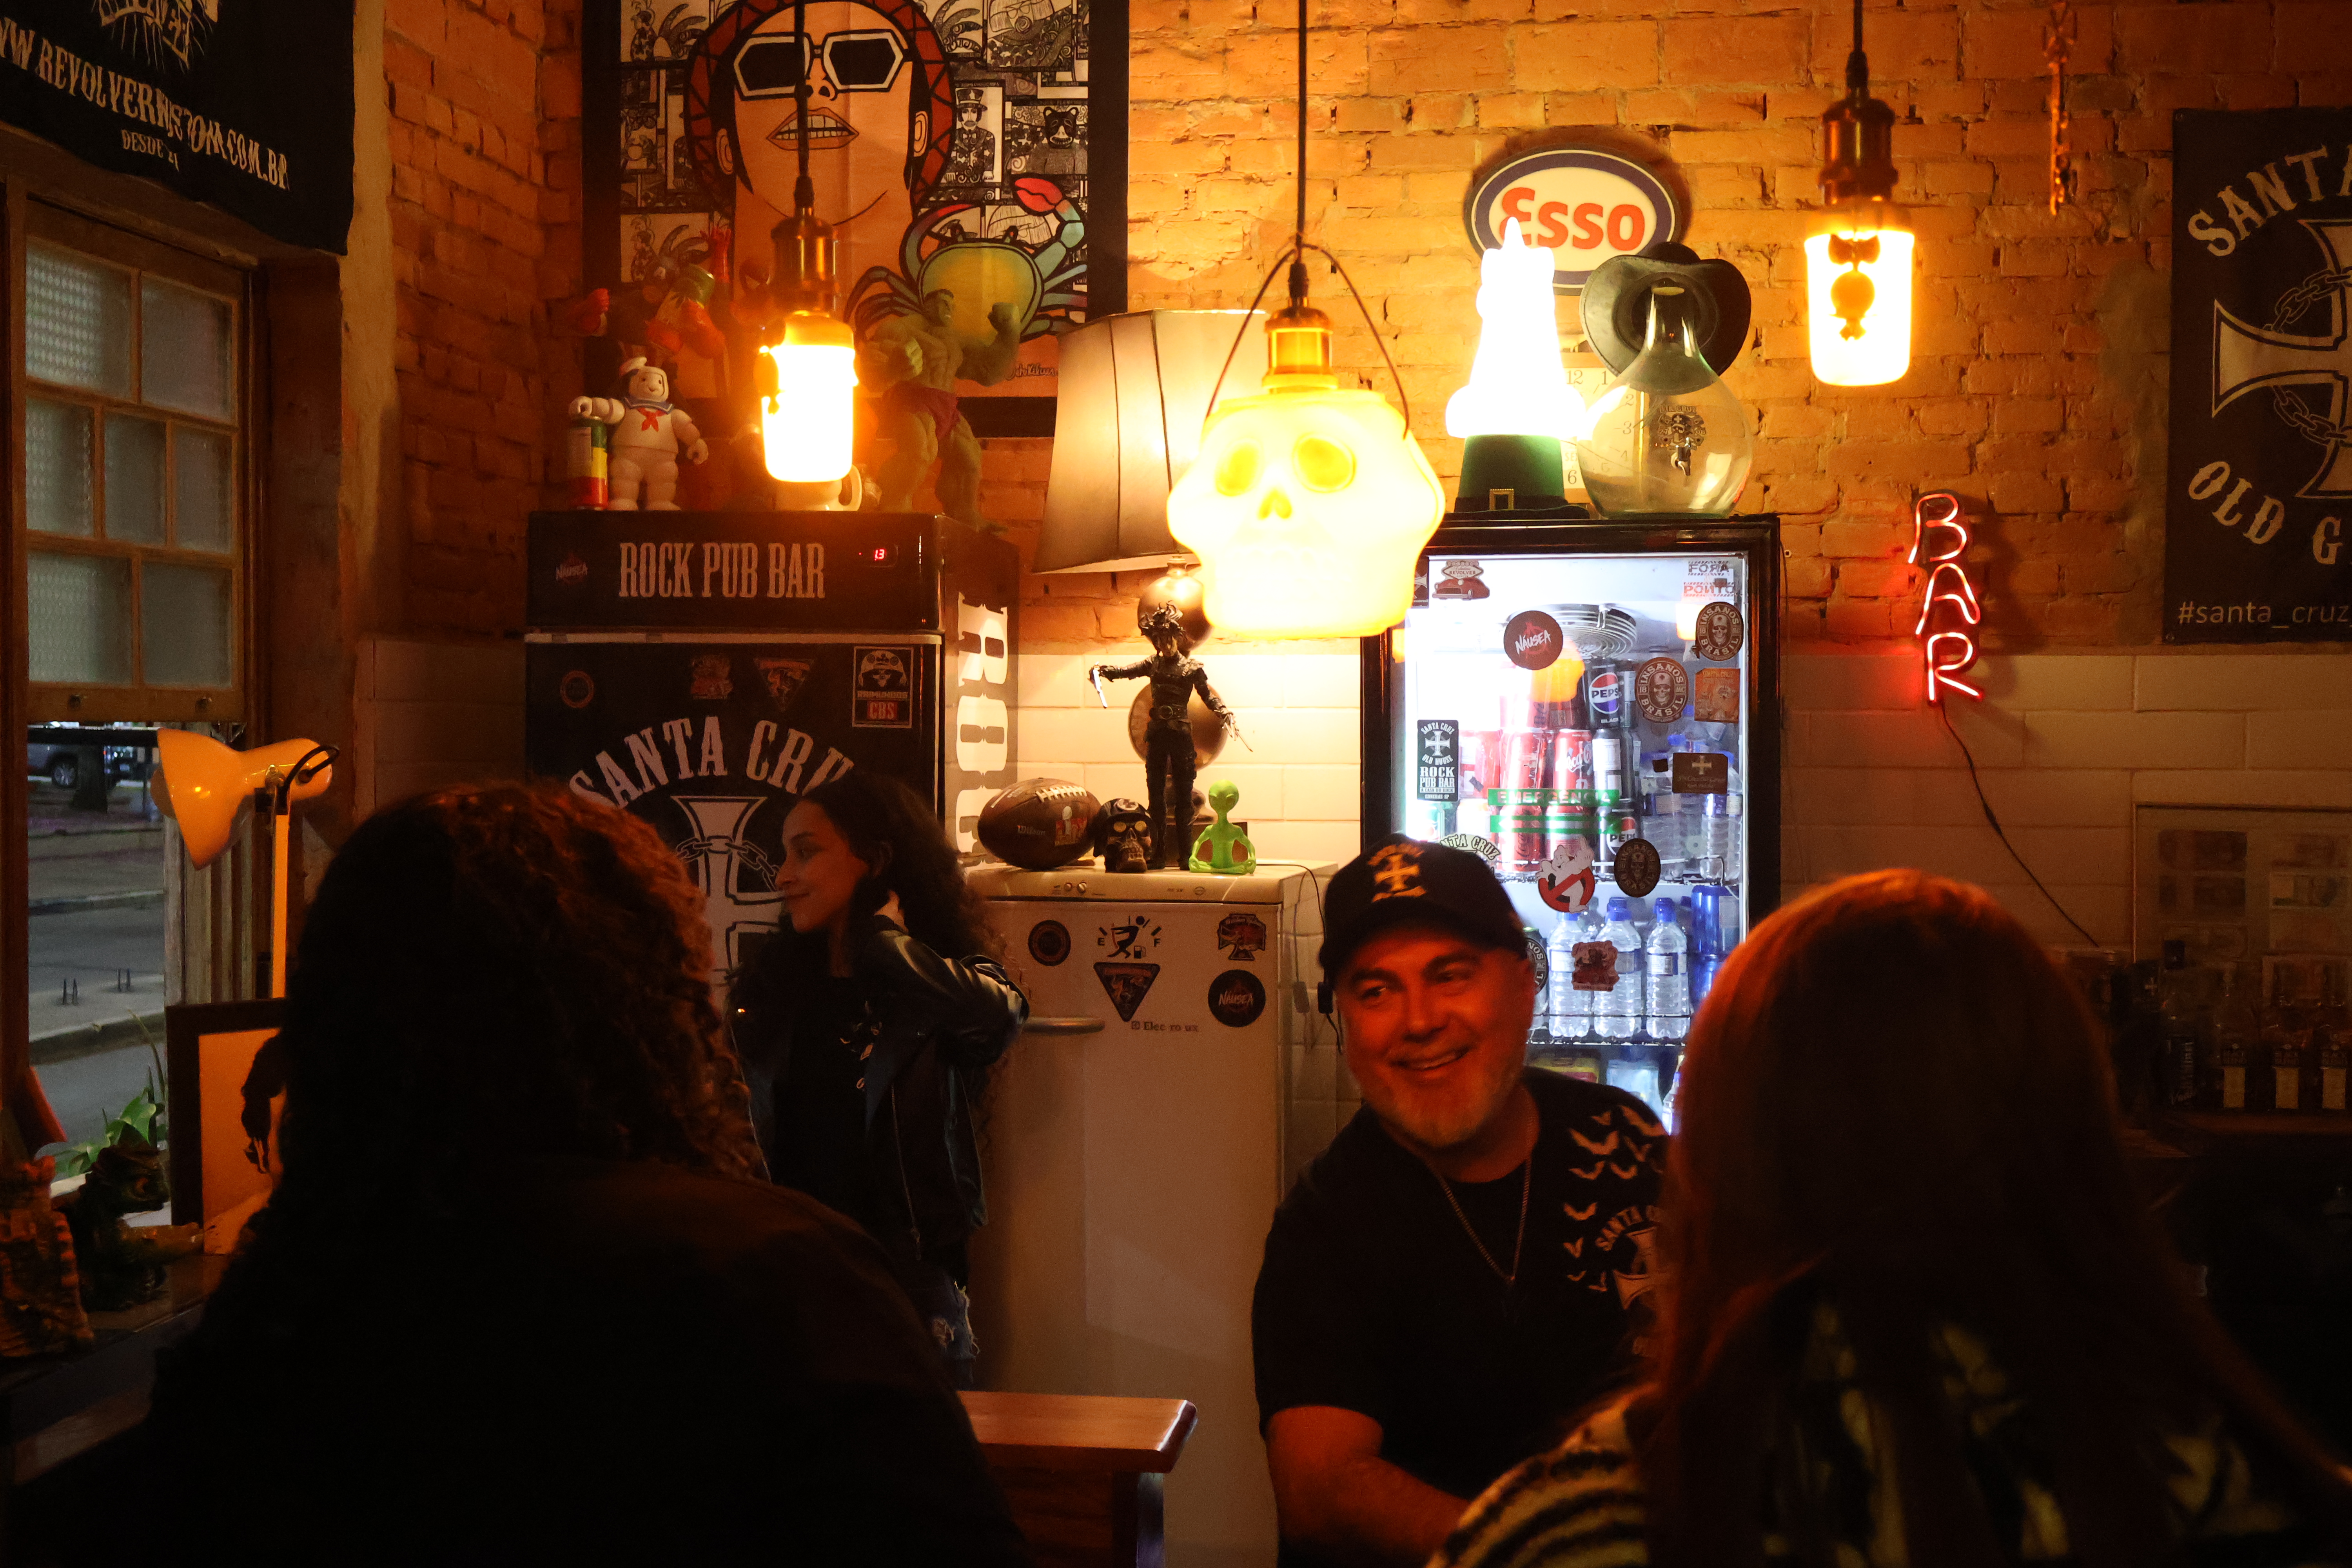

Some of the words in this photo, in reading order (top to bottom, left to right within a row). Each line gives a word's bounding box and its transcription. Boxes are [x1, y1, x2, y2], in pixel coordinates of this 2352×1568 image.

[121, 130, 163, 158] DESDE
[1566, 370, 1583, 385] 12
[1601, 370, 1608, 385] 1
[1625, 394, 1634, 406] 2
[1622, 421, 1632, 435] 3
[1568, 470, 1577, 485] 6
[2188, 461, 2285, 544] OLD
[619, 542, 694, 598] ROCK
[701, 542, 758, 599] PUB
[766, 542, 826, 599] BAR
[1907, 494, 1982, 702] BAR
[1700, 606, 1739, 624] INSANOS
[2178, 601, 2352, 628] #santa_cruz
[1701, 639, 1739, 655] BRASIL
[1640, 663, 1684, 684] INSANOS
[1592, 688, 1619, 698] PEPS
[1641, 698, 1684, 716] BRASIL
[956, 592, 1009, 876] ROC
[1421, 722, 1439, 735] SANTA
[1440, 722, 1455, 735] CRUZ
[569, 716, 728, 809] SANTA
[746, 720, 855, 797] CRU
[1422, 754, 1434, 764] OLD
[1435, 755, 1454, 765] HOUSE
[1420, 766, 1455, 777] ROCK
[1420, 777, 1438, 788] PUB
[1438, 777, 1455, 788] BAR
[1440, 834, 1468, 848] NTA
[1471, 836, 1501, 860] CRUZ
[1098, 937, 1105, 946] E
[1154, 938, 1161, 947] F
